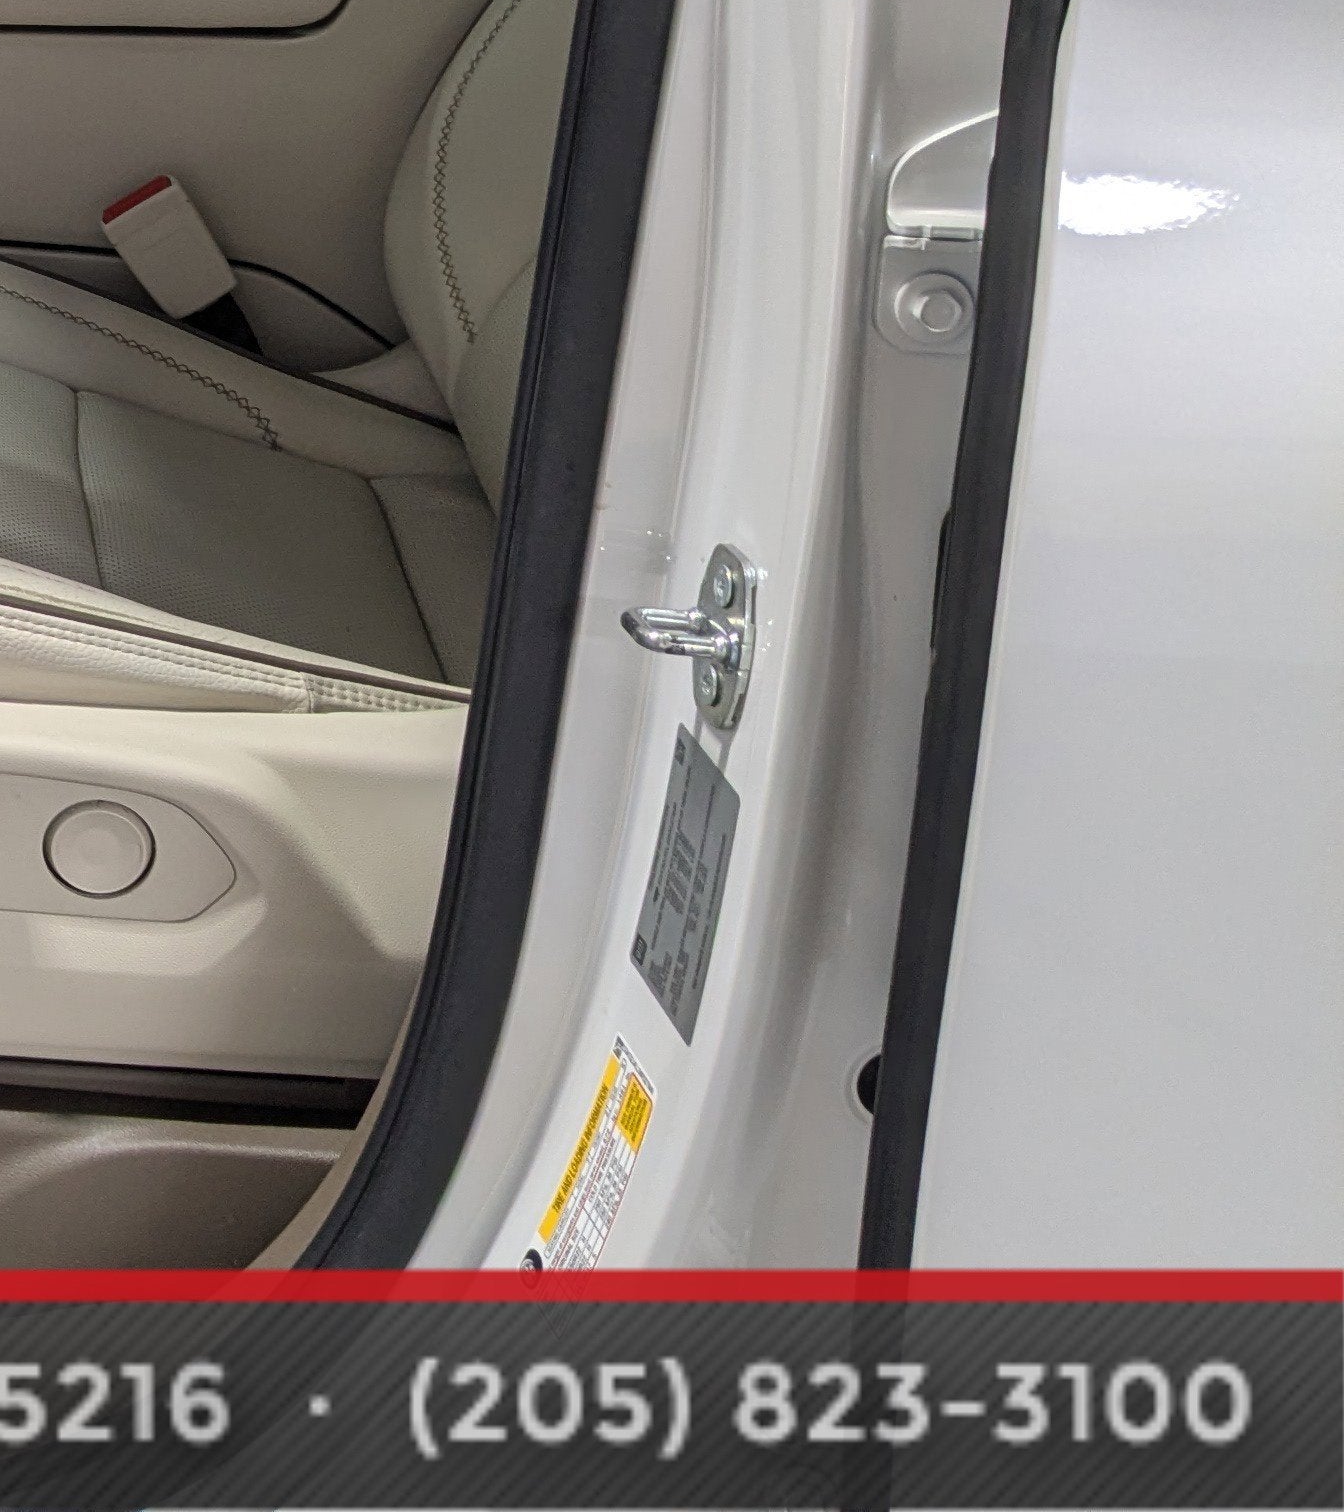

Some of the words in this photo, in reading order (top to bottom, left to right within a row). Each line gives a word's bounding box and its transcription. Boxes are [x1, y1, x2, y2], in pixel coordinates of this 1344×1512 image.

[552, 1193, 564, 1213] TIRE
[560, 1175, 572, 1194] AND
[568, 1139, 587, 1176] LOADING
[582, 1083, 609, 1141] INFORMATION
